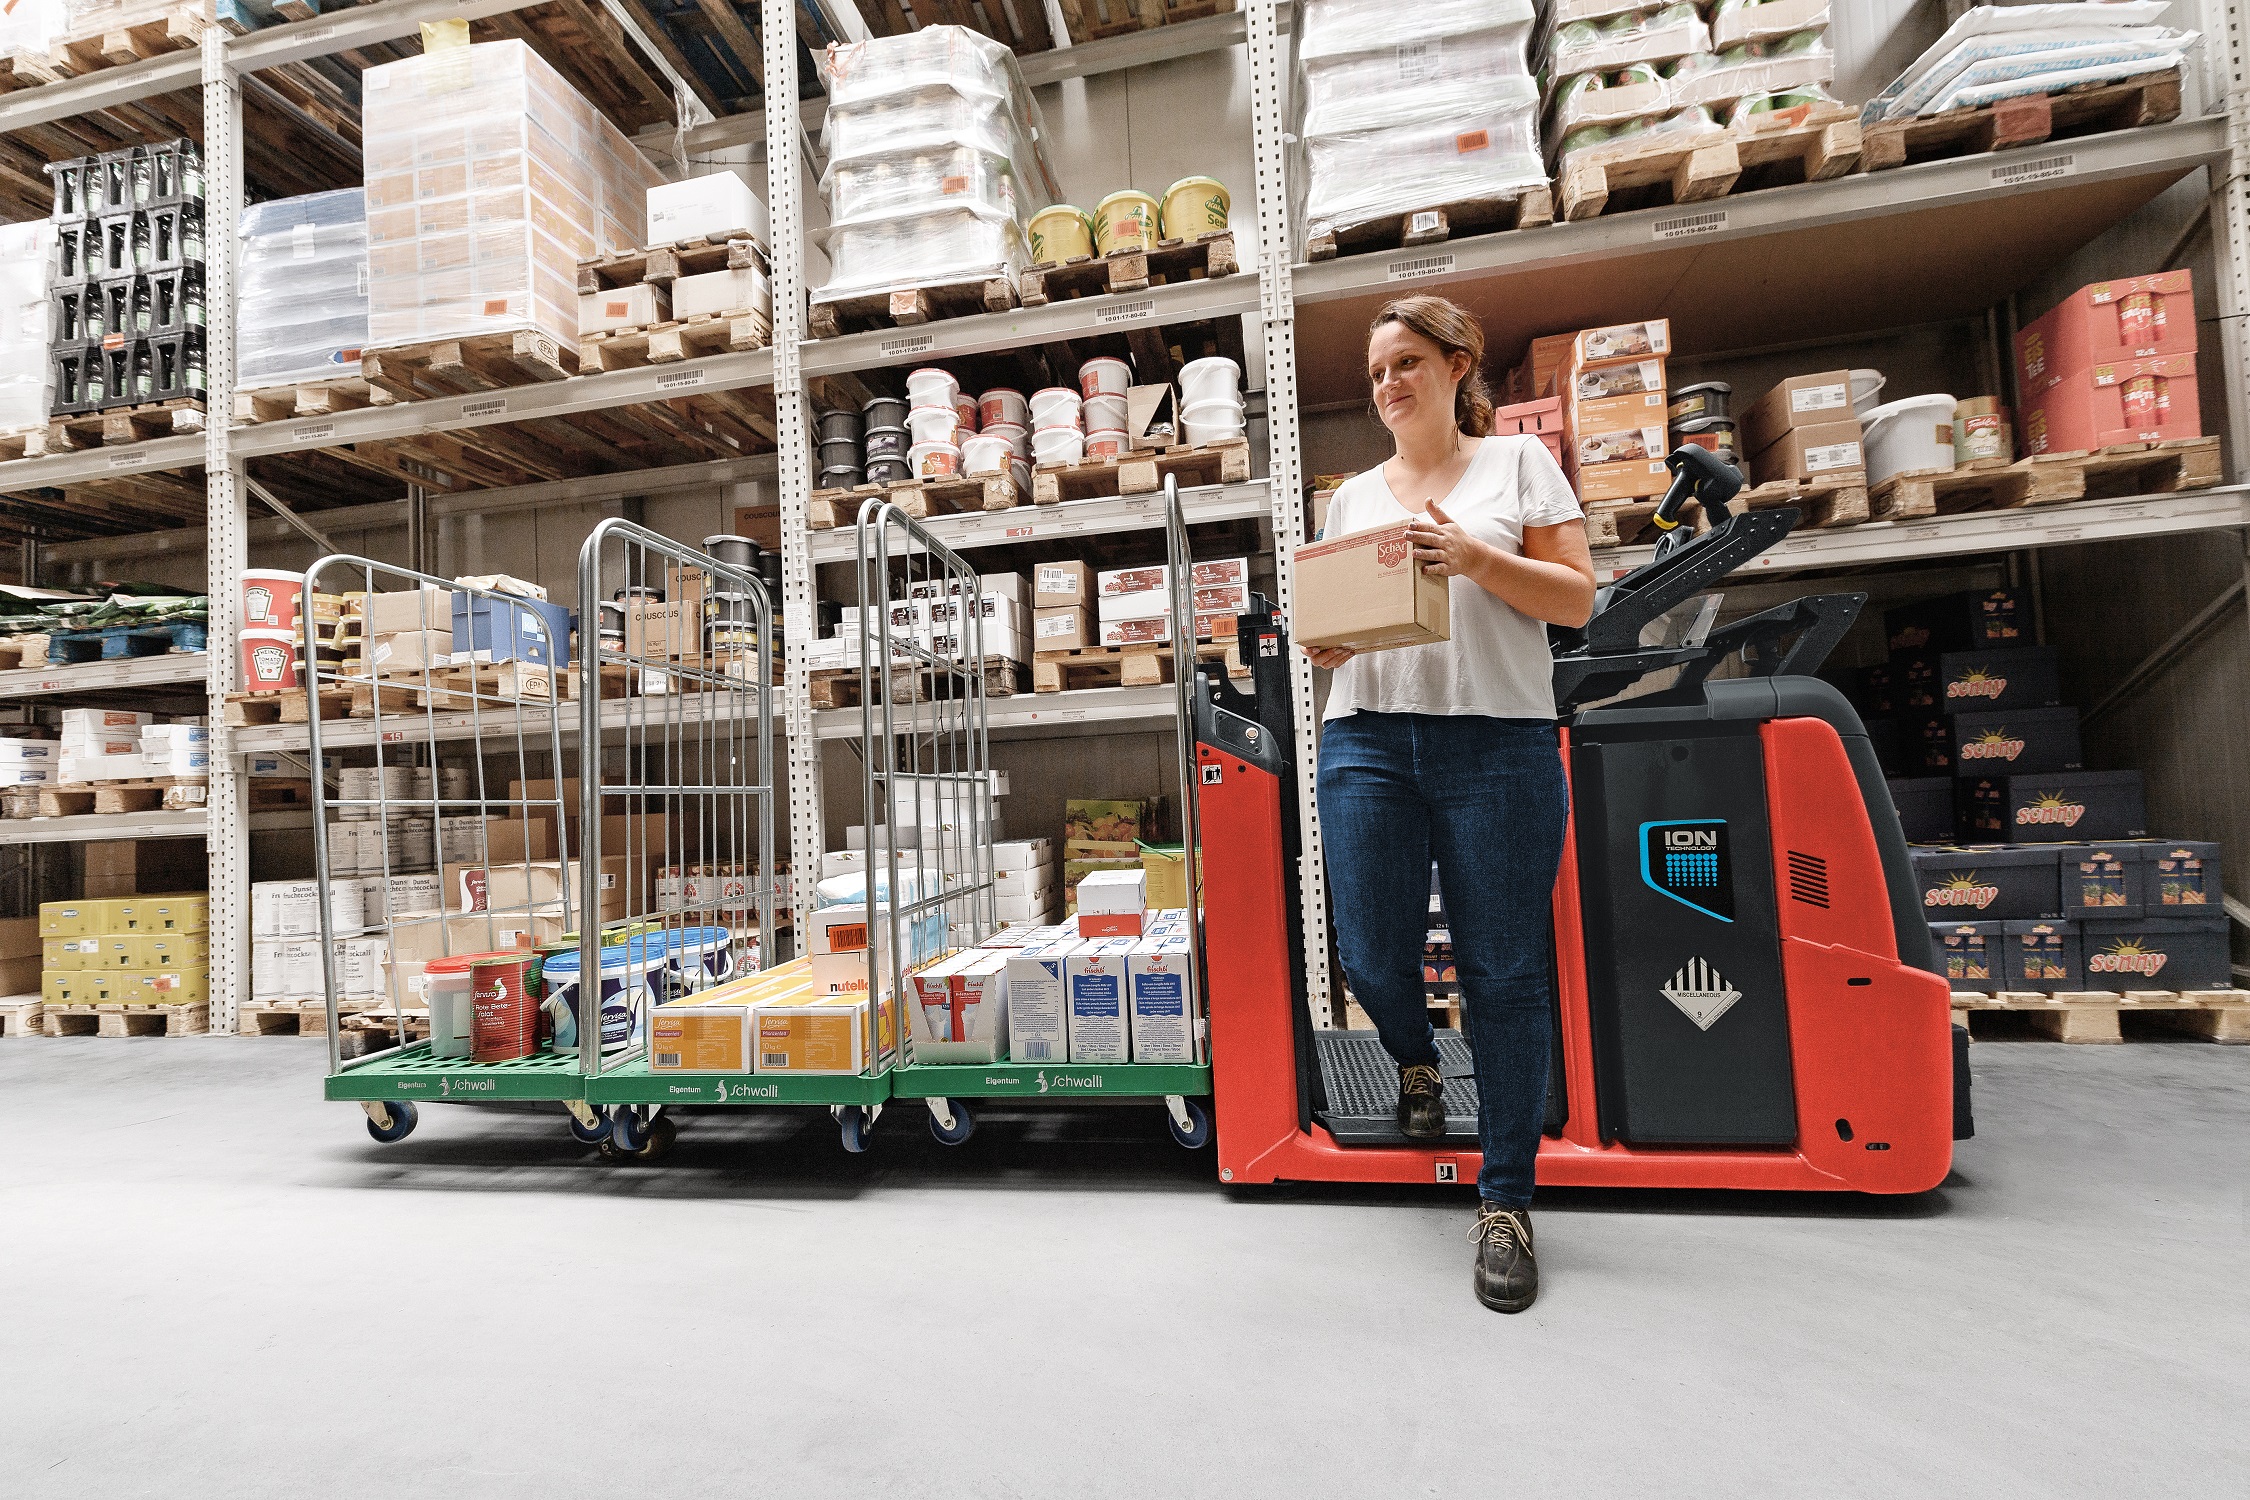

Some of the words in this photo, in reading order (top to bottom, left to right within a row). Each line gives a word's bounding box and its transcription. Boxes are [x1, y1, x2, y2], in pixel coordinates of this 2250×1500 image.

[1016, 528, 1030, 536] 17
[1378, 542, 1407, 558] Schär
[1946, 678, 2008, 700] sonny
[1961, 740, 2025, 762] sonny
[2016, 804, 2085, 828] sonny
[1664, 830, 1717, 846] ION
[1924, 886, 1998, 910] sonny
[2088, 953, 2168, 976] sonny
[397, 1082, 427, 1090] Eigentum
[452, 1078, 495, 1091] Schwalli
[985, 1077, 1020, 1085] Eigentum
[1051, 1075, 1102, 1088] Schwalli
[669, 1086, 701, 1094] Eigentum
[730, 1084, 778, 1098] Schwalli
